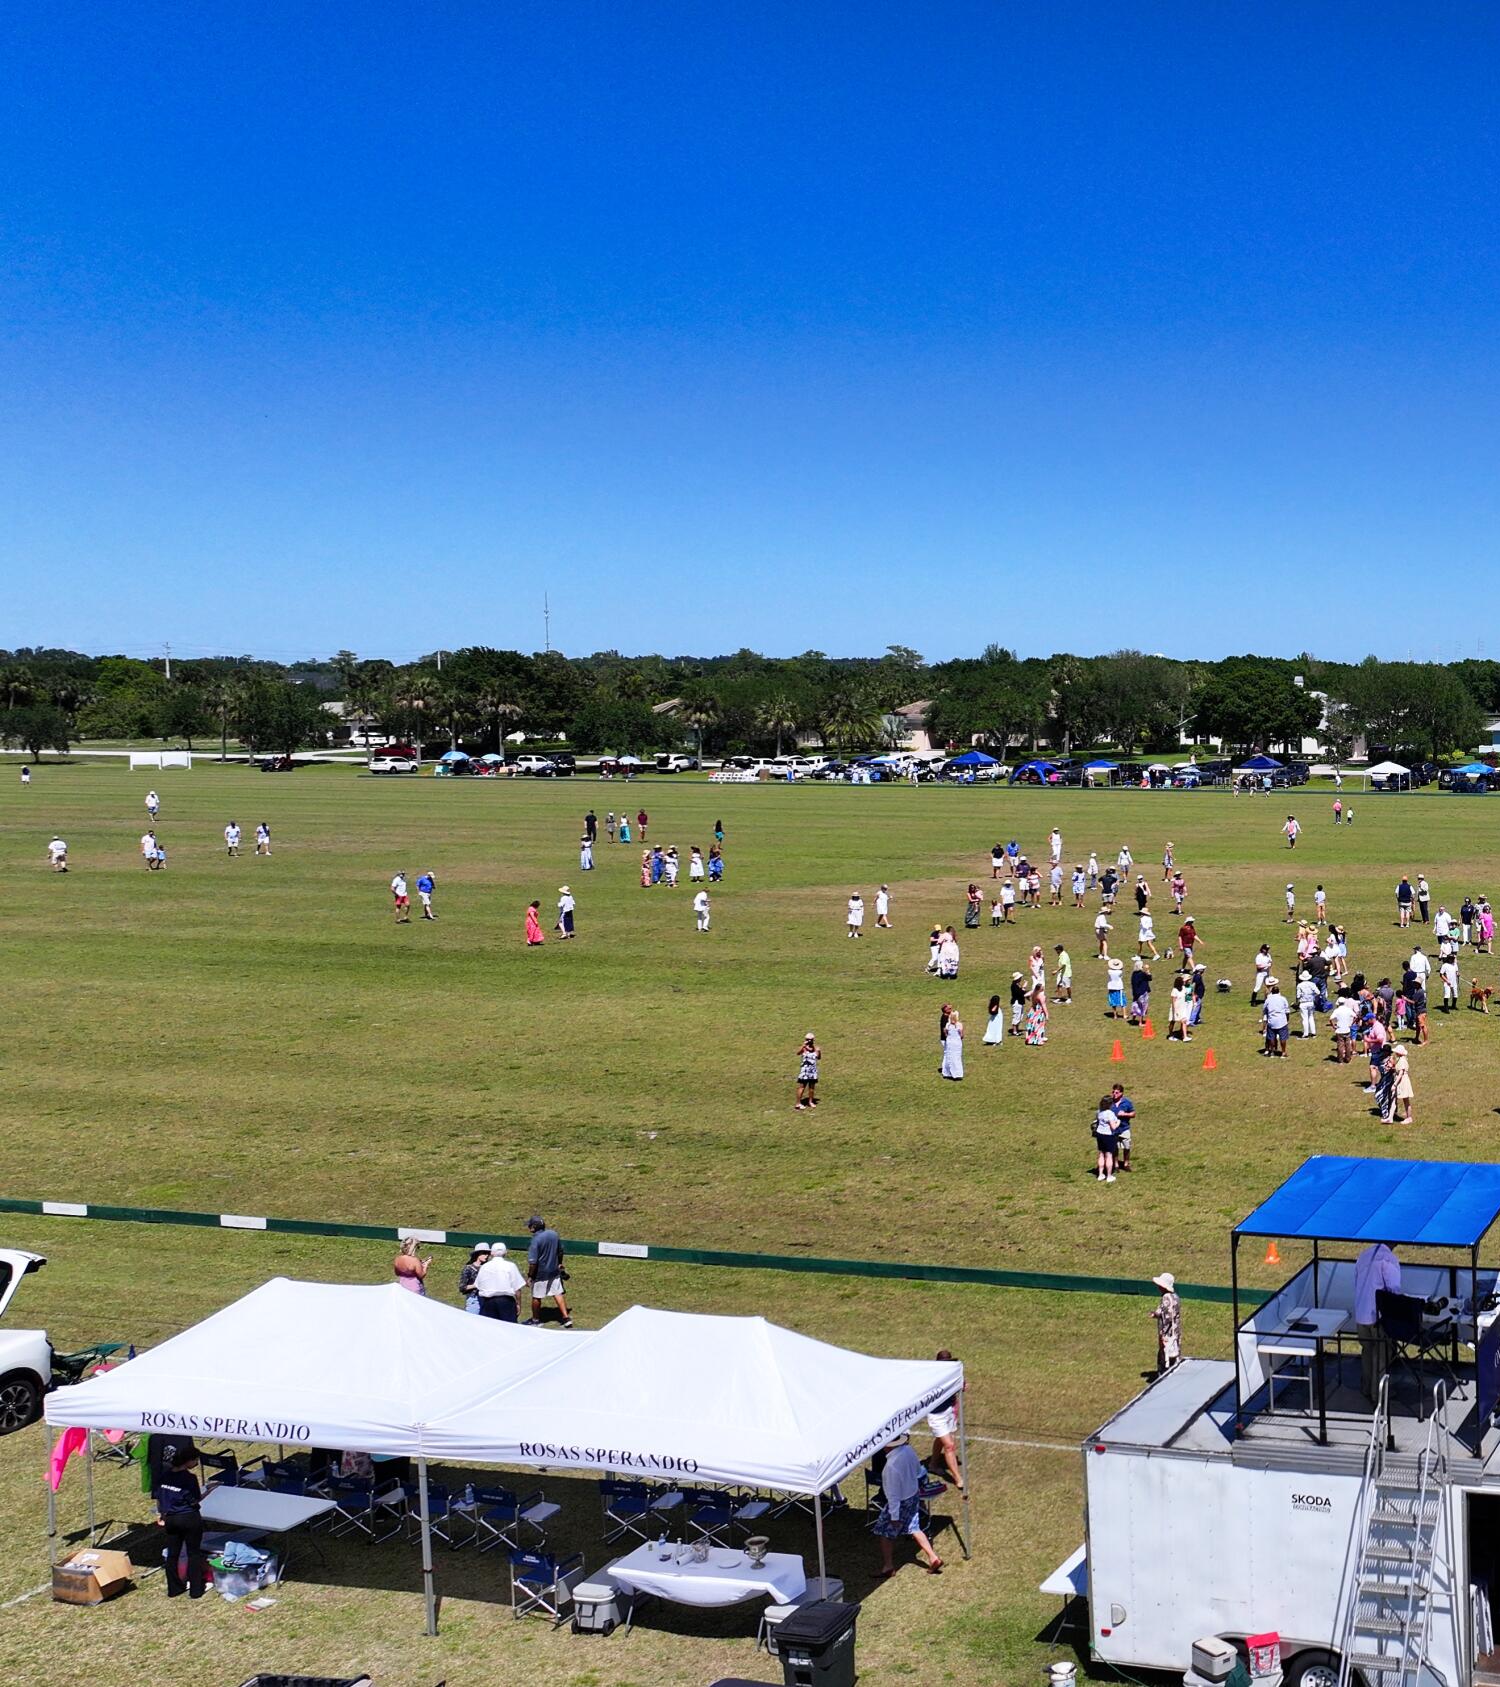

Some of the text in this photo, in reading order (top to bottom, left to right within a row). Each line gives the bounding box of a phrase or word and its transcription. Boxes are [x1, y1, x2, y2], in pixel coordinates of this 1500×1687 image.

[141, 1412, 311, 1441] ROSAS SPERANDIO
[520, 1442, 699, 1474] ROSAS SPERANDIO
[1291, 1493, 1332, 1508] SKODA
